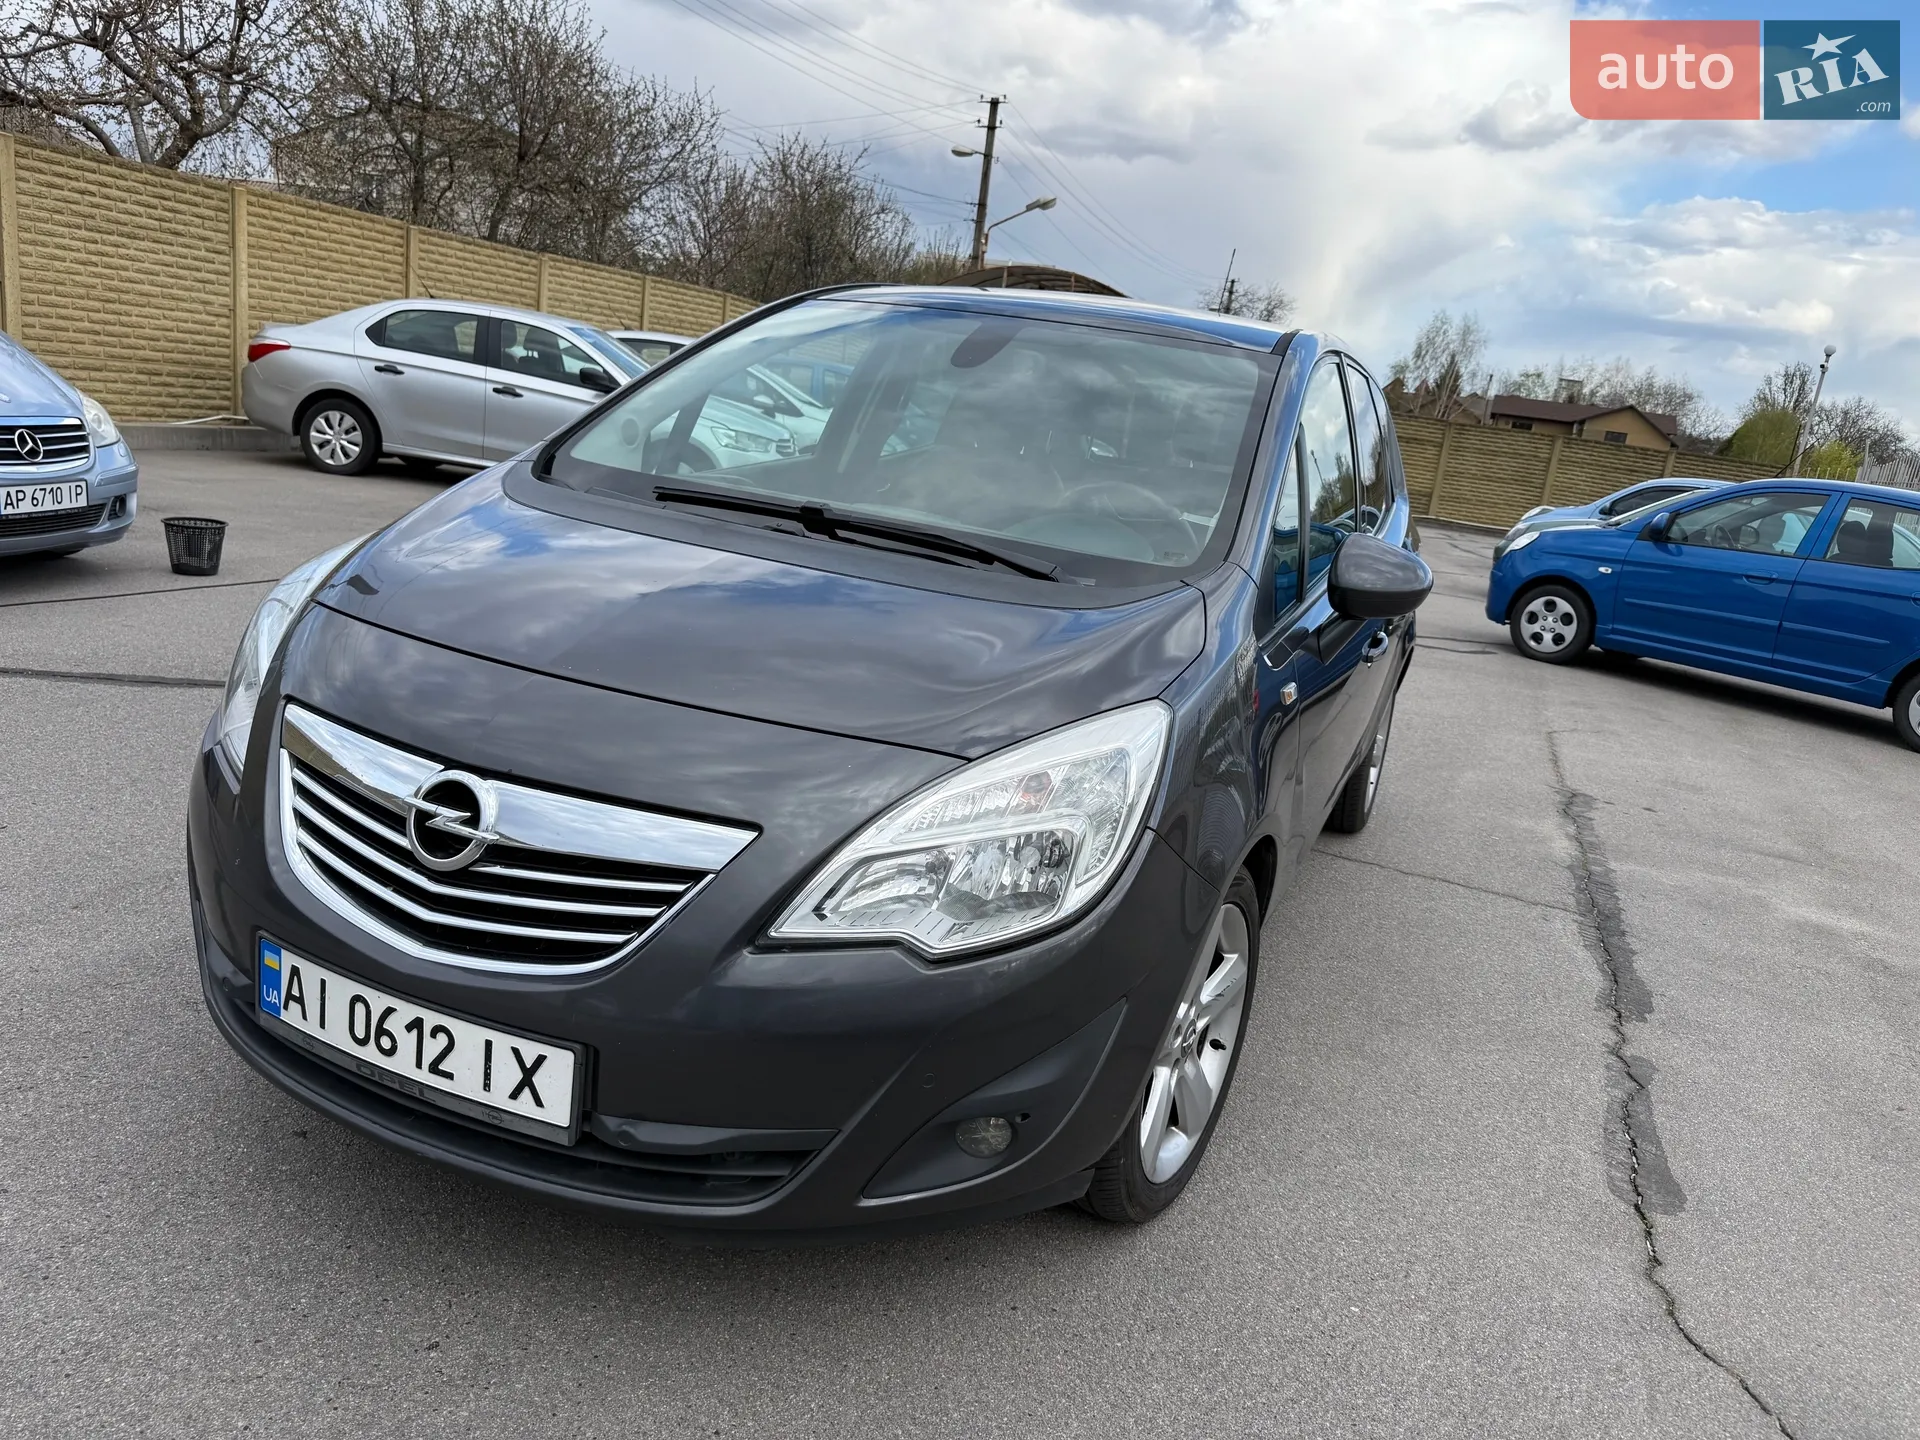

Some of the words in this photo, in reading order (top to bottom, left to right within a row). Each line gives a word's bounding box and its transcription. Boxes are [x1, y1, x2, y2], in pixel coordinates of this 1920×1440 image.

[4, 490, 26, 510] AP
[31, 487, 62, 507] 6710
[69, 485, 84, 504] IP
[263, 988, 280, 1007] UA
[282, 963, 327, 1031] AI
[348, 993, 456, 1082] 0612
[483, 1038, 548, 1109] IX
[355, 1063, 437, 1103] OPEL
